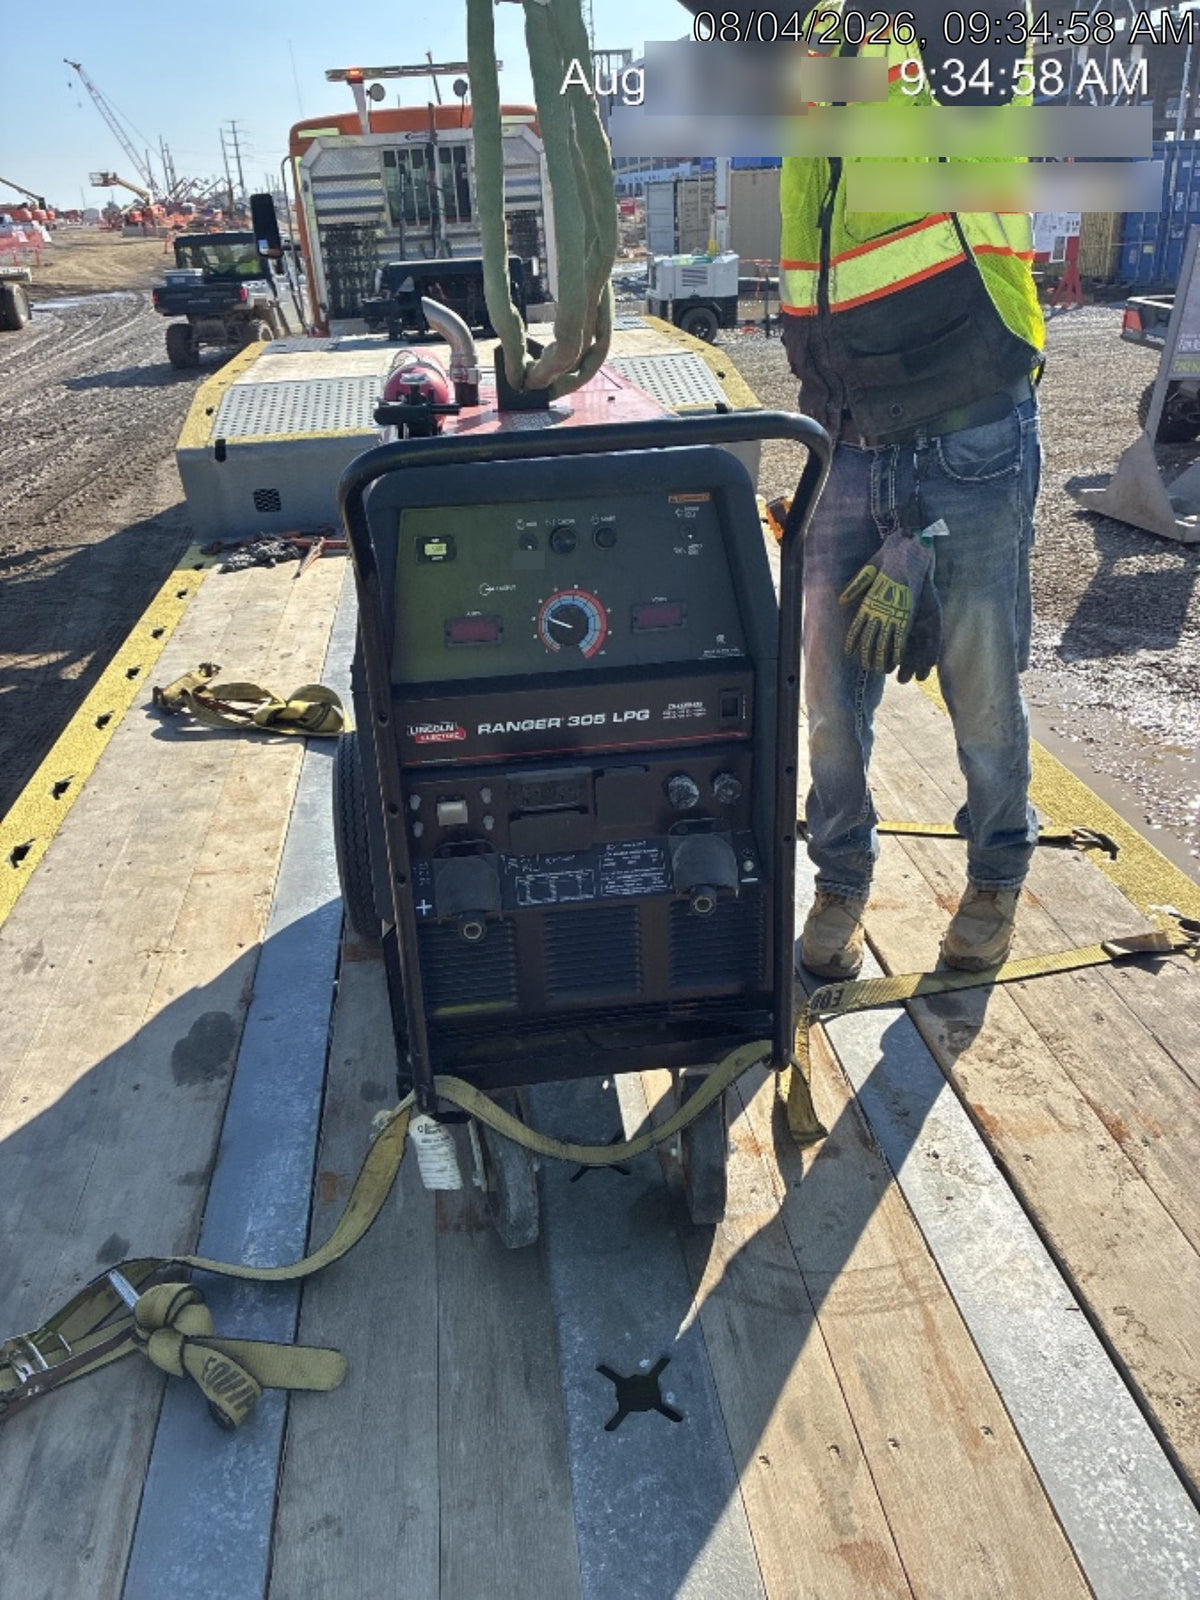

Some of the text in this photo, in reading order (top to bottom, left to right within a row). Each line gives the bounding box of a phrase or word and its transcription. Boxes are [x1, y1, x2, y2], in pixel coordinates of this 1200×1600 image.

[409, 723, 455, 736] LINCOLN
[477, 716, 561, 735] RANGER
[567, 713, 605, 727] 305
[612, 708, 650, 723] LPG
